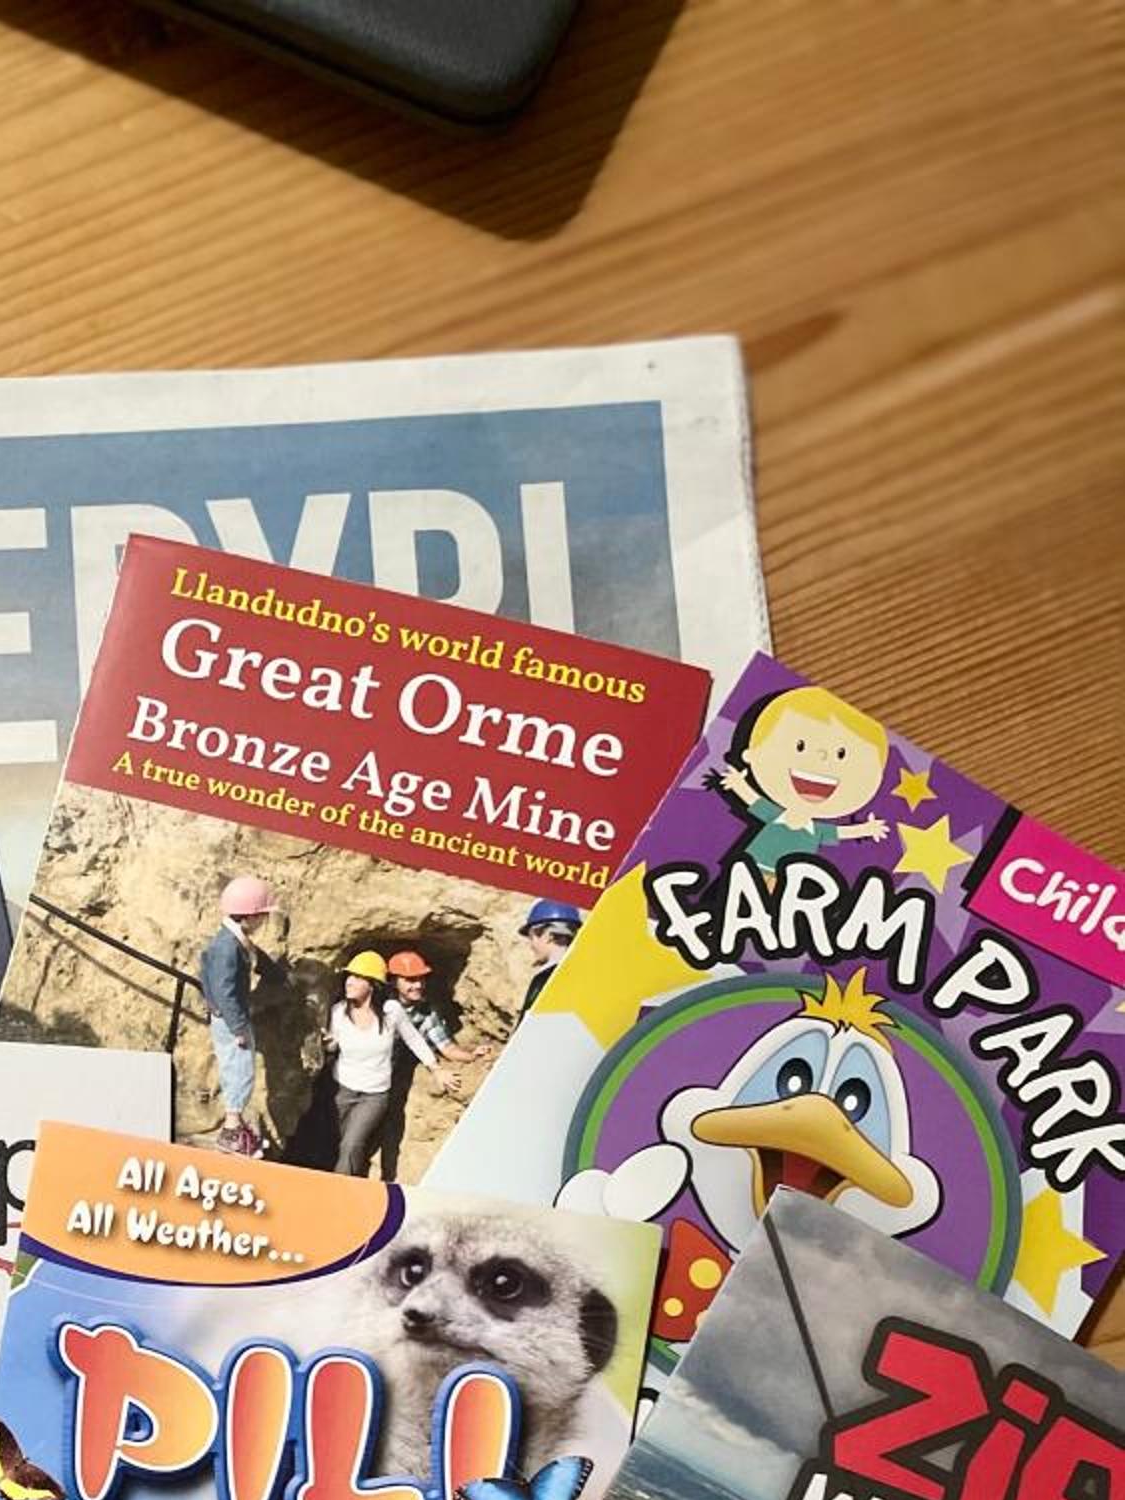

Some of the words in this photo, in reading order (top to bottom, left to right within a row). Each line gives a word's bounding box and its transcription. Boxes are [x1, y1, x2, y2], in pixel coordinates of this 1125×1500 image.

[160, 618, 382, 721] Great
[398, 673, 625, 777] Orme
[170, 567, 390, 646] Llandudno's
[398, 622, 506, 672] world
[512, 645, 647, 704] famous
[112, 750, 135, 775] A
[140, 763, 201, 793] true
[207, 772, 316, 819] wonder
[320, 802, 357, 825] of
[359, 810, 405, 840] the
[411, 826, 519, 866] ancient
[525, 853, 610, 891] world
[127, 695, 330, 784] Bronze
[342, 750, 454, 818] Age
[463, 778, 617, 853] Mine
[648, 858, 929, 988] FARM
[930, 937, 1125, 1184] PARK
[65, 1200, 114, 1238] All
[126, 1207, 306, 1266] Weather...
[116, 1155, 165, 1195] All
[174, 1162, 266, 1214] Ages,
